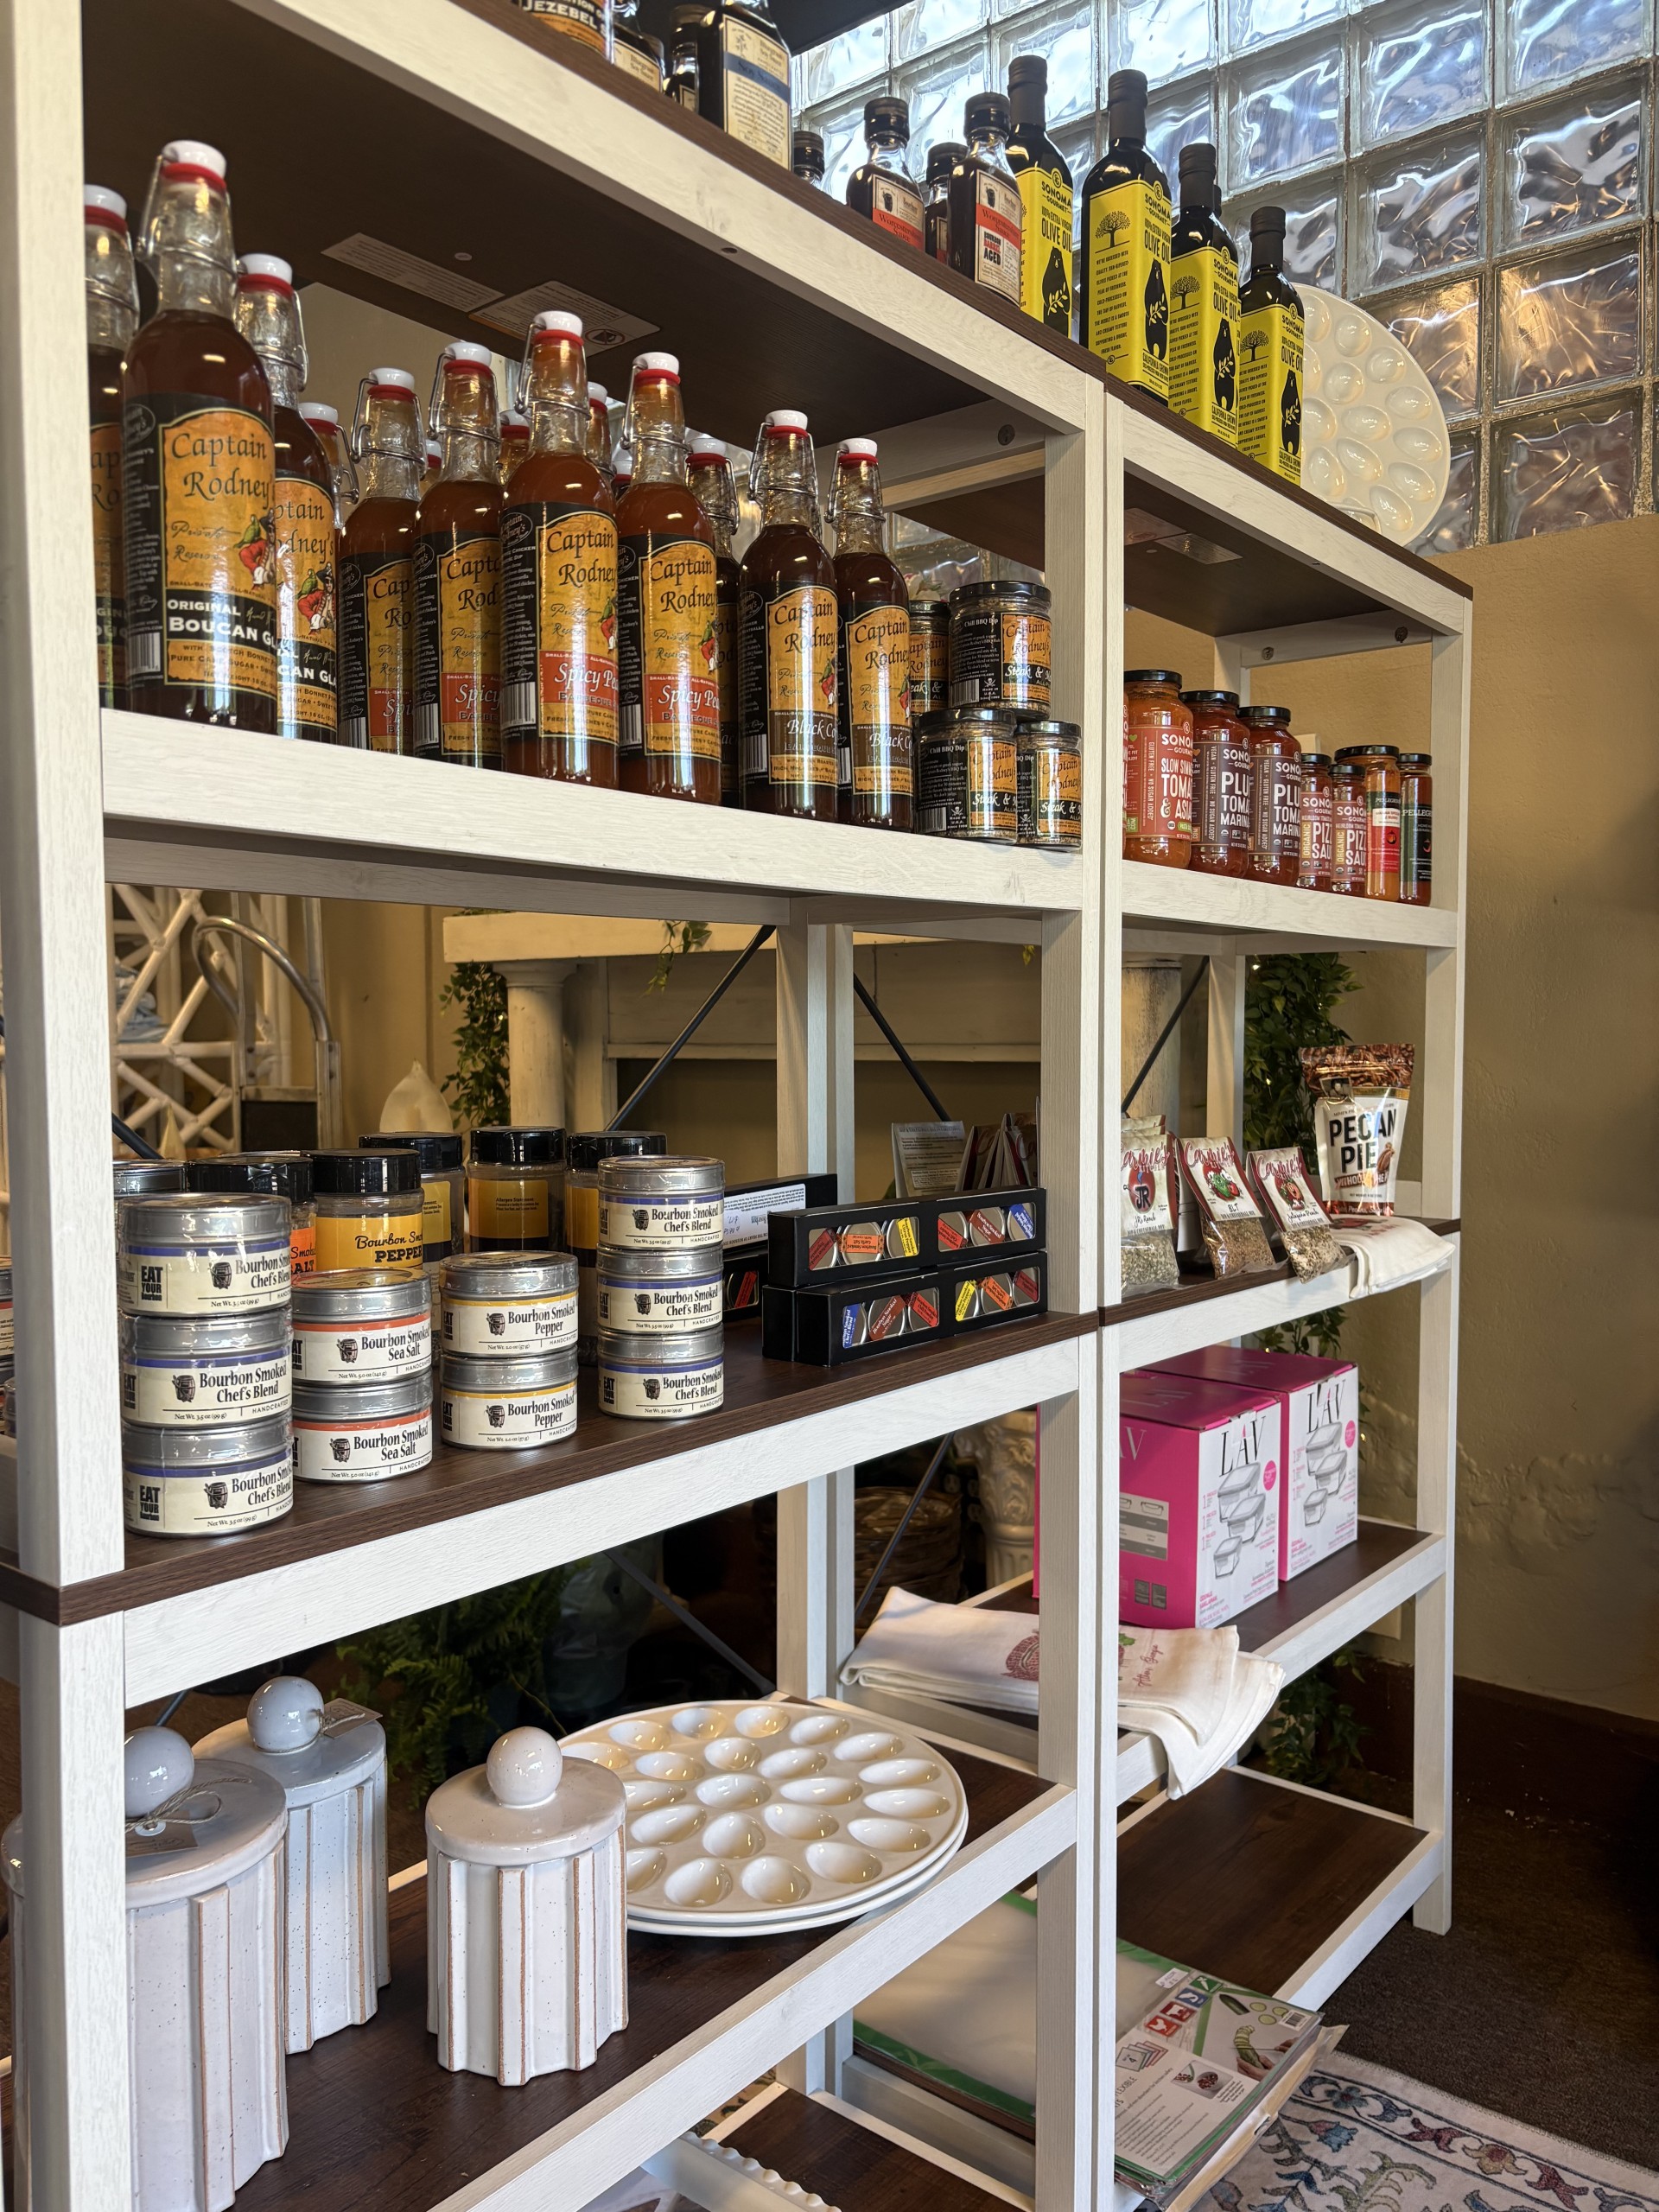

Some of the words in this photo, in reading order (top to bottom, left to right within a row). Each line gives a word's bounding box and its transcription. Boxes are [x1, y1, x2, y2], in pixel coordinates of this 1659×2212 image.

[523, 0, 597, 30] JEZEBEL
[1041, 181, 1071, 207] SONOMA
[1046, 195, 1068, 213] GOURMET
[1145, 194, 1171, 219] SONOMA
[1148, 209, 1166, 226] GOURMET
[1050, 209, 1061, 226] EXTRA
[1062, 215, 1071, 232] VIRGIN
[984, 232, 1001, 245] BOURBON
[1041, 219, 1060, 243] OLIVE
[1062, 231, 1071, 252] OIL
[984, 248, 1001, 266] AGED
[1145, 230, 1160, 257] OLIVE
[1161, 243, 1170, 264] OIL
[1214, 258, 1237, 281] SONOMA
[1214, 292, 1228, 316] OLIVE
[1282, 315, 1304, 335] SONOMA
[1281, 346, 1294, 368] OLIVE
[171, 433, 268, 467] Captain
[546, 527, 614, 559] Captain
[447, 557, 499, 584] Capta
[651, 555, 713, 587] Captain
[167, 599, 242, 616] ORIGINAL
[774, 598, 833, 629] Captain
[168, 616, 258, 642] BOUCAN
[855, 617, 908, 646] Captain
[963, 619, 976, 628] Chill
[976, 618, 988, 626] BBQ
[554, 662, 601, 692] Spicy
[1005, 665, 1033, 678] Steak
[1035, 666, 1044, 678] &
[658, 685, 702, 712] Spicy
[787, 719, 826, 741] Black
[869, 732, 905, 752] Black
[930, 746, 941, 754] Chill
[955, 744, 965, 753] Dip
[1160, 757, 1179, 772] SLOW
[1160, 773, 1192, 800] TOMA
[1221, 771, 1249, 796] PLU
[1002, 793, 1011, 805] &
[1274, 783, 1300, 808] PLU
[1039, 801, 1065, 813] Steak
[1069, 802, 1077, 812] &
[1160, 798, 1171, 818] &
[1175, 799, 1192, 821] ASIA
[1312, 842, 1332, 860] SAU
[1345, 849, 1366, 867] SAU
[1329, 1108, 1397, 1147] PECAN
[1341, 1141, 1377, 1173] PIE
[1135, 1185, 1151, 1210] JR
[1227, 1203, 1239, 1213] BLT
[652, 1207, 691, 1221] Bourbon
[693, 1204, 719, 1218] Smoked
[664, 1220, 690, 1233] Chef's
[691, 1219, 712, 1230] Blend
[354, 1233, 407, 1249] Bourbon
[141, 1265, 163, 1283] EAT
[236, 1255, 278, 1274] Bourbon
[141, 1283, 162, 1294] YOUR
[251, 1274, 277, 1289] Chef's
[654, 1291, 693, 1305] Bourbon
[694, 1284, 718, 1302] Smoked
[508, 1307, 550, 1325] Bourbon
[551, 1300, 575, 1320] Smoked
[666, 1304, 691, 1317] Chef's
[692, 1301, 712, 1314] Blend
[361, 1332, 406, 1351] Bourbon
[407, 1324, 430, 1344] Smoked
[535, 1319, 564, 1337] Pepper
[388, 1347, 405, 1362] Sea
[406, 1342, 421, 1358] Salt
[200, 1370, 254, 1389] Bourbon
[255, 1360, 287, 1382] Smoked
[663, 1375, 701, 1389] Bourbon
[702, 1366, 722, 1384] Smoked
[216, 1387, 251, 1403] Chef's
[253, 1380, 279, 1397] Blend
[675, 1386, 700, 1401] Chef's
[700, 1382, 717, 1397] Blend
[251, 1398, 289, 1414] HANDCRAFTED
[508, 1400, 550, 1417] Bourbon
[550, 1390, 575, 1411] Smoked
[534, 1410, 563, 1428] Pepper
[353, 1432, 400, 1451] Bourbon
[401, 1424, 429, 1445] Smoked
[381, 1446, 399, 1461] Sea
[400, 1441, 417, 1458] Salt
[232, 1471, 276, 1493] Bourbon
[140, 1484, 161, 1503] EAT
[247, 1488, 276, 1506] Chef's
[140, 1503, 160, 1514] YOUR
[1116, 2075, 1139, 2097] LEXIBLE
